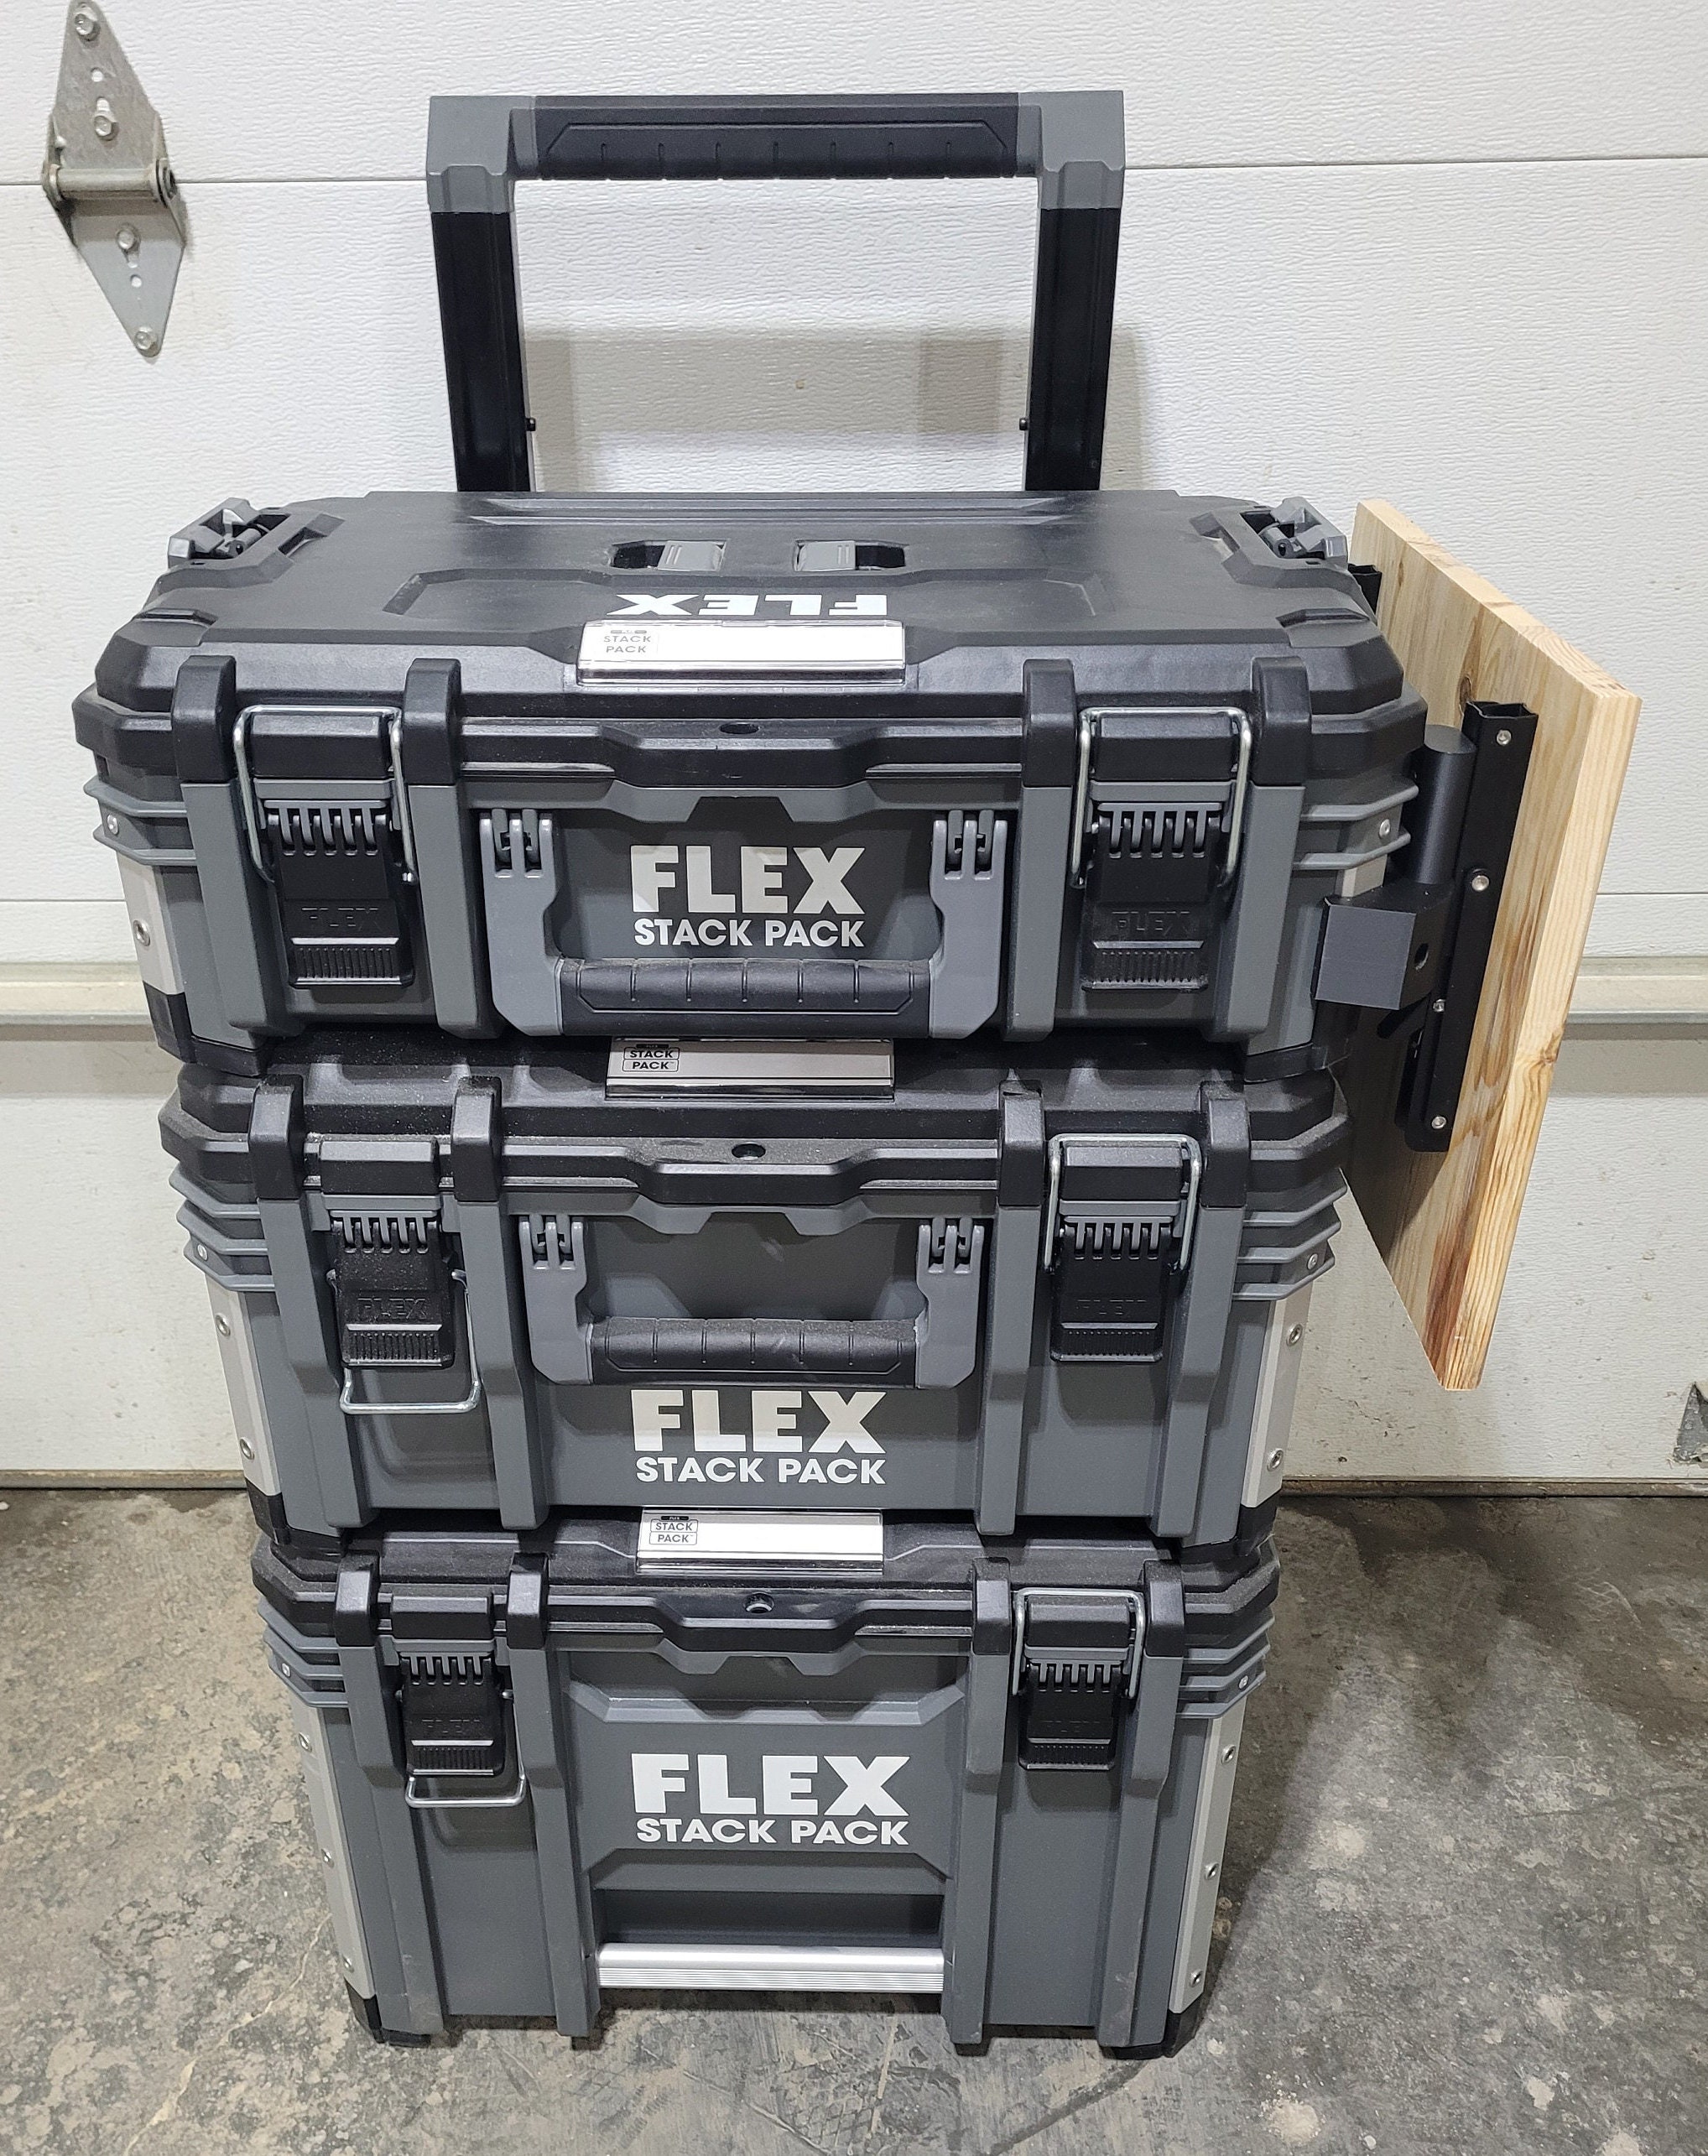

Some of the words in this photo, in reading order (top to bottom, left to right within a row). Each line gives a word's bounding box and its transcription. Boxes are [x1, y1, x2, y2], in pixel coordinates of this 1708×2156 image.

[605, 594, 888, 616] FLEX
[630, 845, 865, 914] FLEX
[633, 918, 753, 945] STACK
[764, 919, 865, 947] PACK
[629, 1049, 673, 1058] STACK
[632, 1061, 669, 1070] PACK
[631, 1389, 887, 1453] FLEX
[636, 1456, 765, 1483] STACK
[778, 1458, 886, 1484] PACK
[655, 1522, 693, 1531] STACK
[657, 1534, 689, 1543] PACK
[631, 1753, 910, 1816] FLEX
[636, 1818, 777, 1843] STACK
[790, 1820, 909, 1845] PACK
